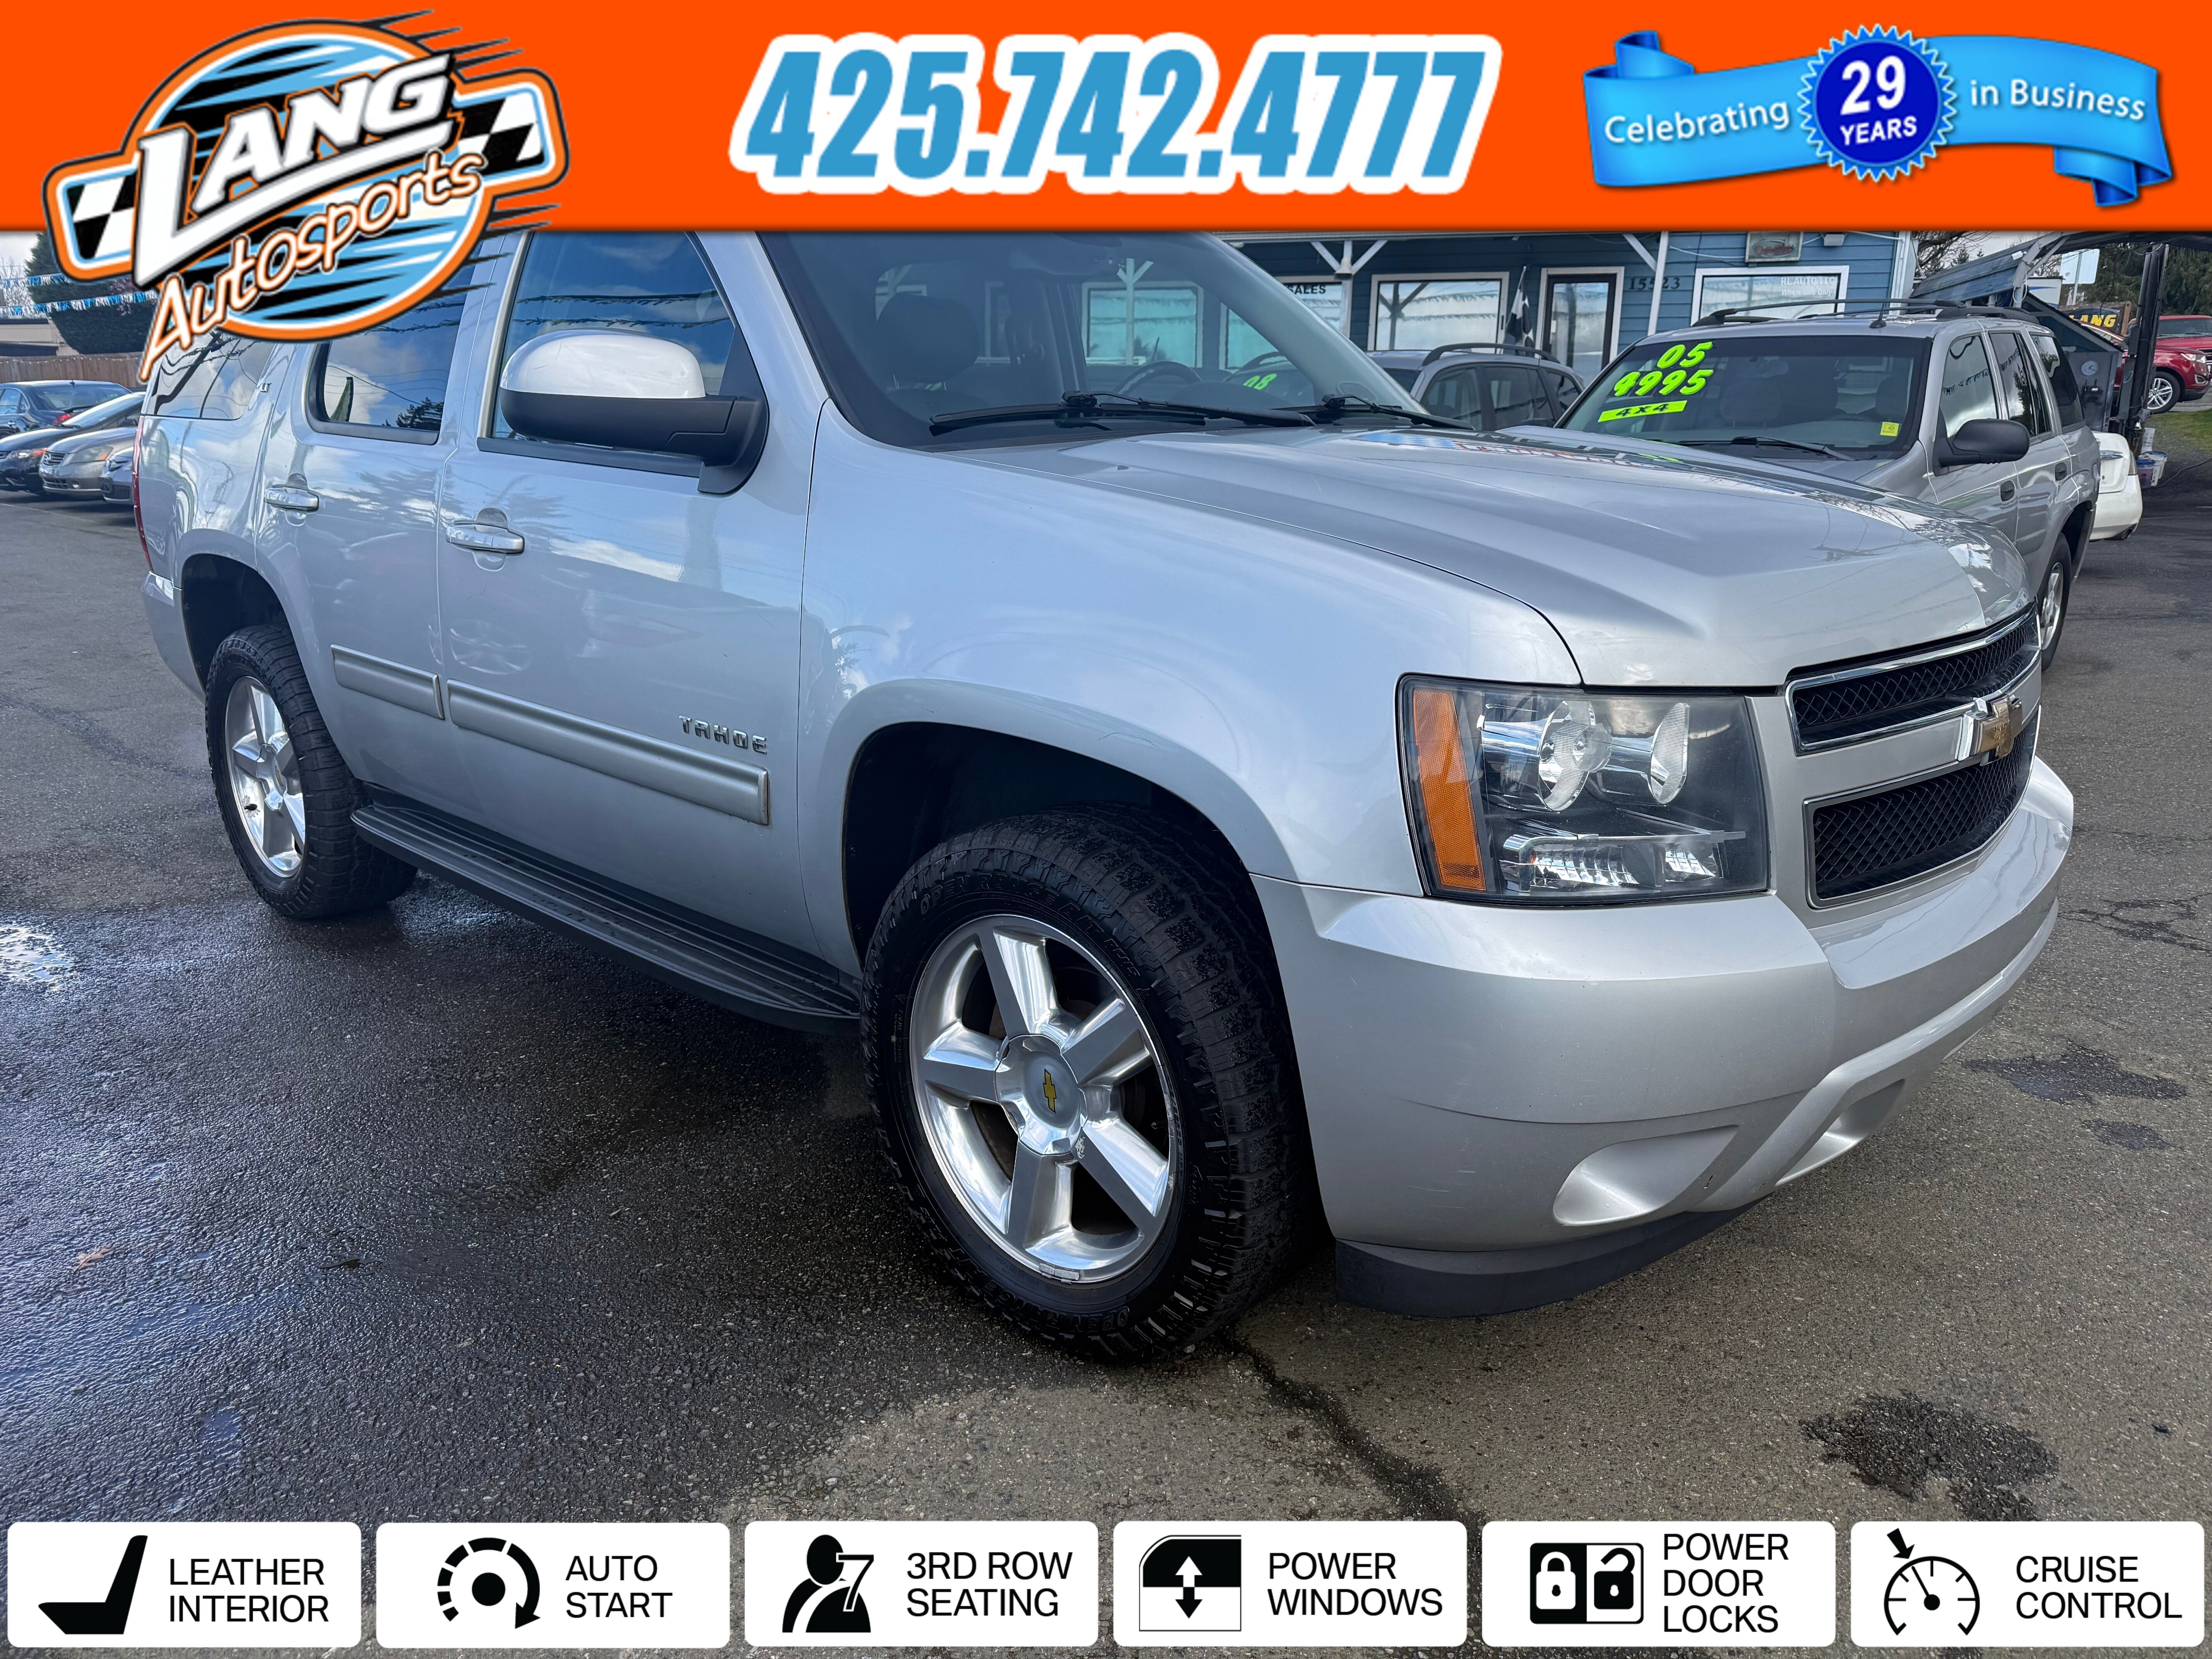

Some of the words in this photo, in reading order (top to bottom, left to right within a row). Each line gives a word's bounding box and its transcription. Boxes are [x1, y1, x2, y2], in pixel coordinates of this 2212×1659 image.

[1781, 277, 1792, 285] RL
[1795, 277, 1816, 285] AUTO
[1818, 277, 1836, 285] LLC
[1817, 289, 1832, 297] Only
[1657, 341, 1713, 369] 05
[1242, 373, 1277, 390] 08
[1614, 369, 1714, 397] 4995
[679, 715, 768, 755] TAHOE
